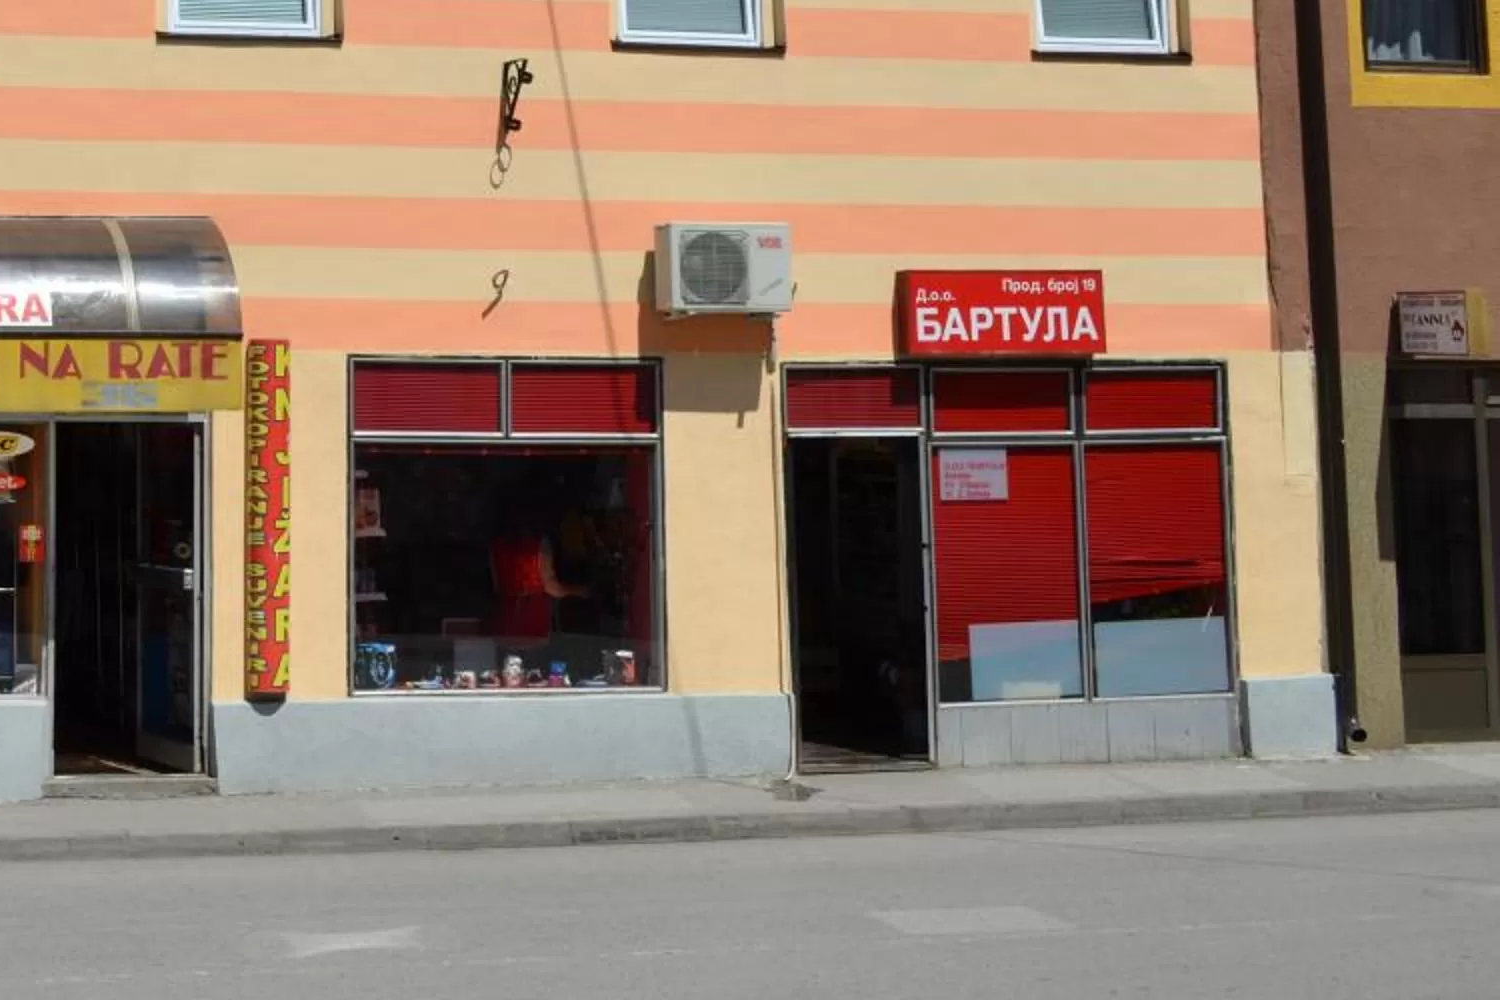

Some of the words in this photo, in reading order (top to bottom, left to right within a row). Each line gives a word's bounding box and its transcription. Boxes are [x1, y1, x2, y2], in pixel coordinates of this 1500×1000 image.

[916, 306, 1099, 342] БАРТУЛА
[19, 341, 82, 380] NA
[107, 342, 229, 381] RATE
[247, 345, 269, 545] FOTOKOPIRANJE
